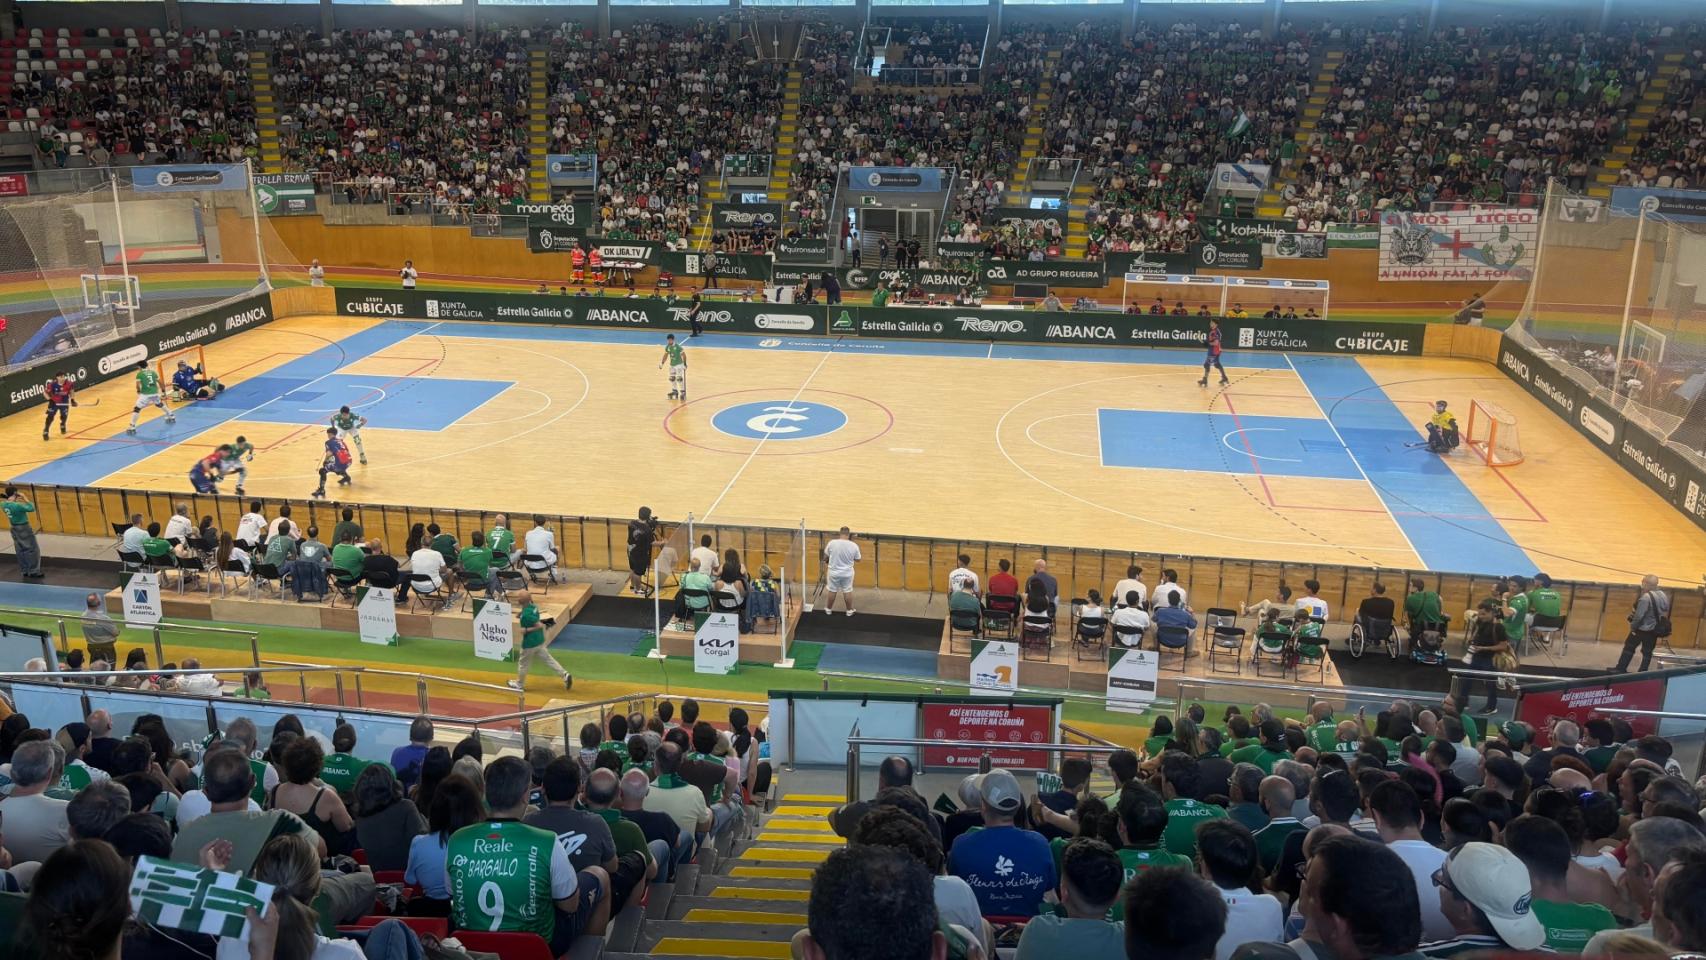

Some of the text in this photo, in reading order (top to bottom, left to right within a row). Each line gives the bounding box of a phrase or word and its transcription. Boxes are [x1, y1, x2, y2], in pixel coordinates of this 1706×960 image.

[284, 174, 310, 184] BRAVA
[516, 204, 574, 214] marineda
[551, 213, 575, 226] city
[1475, 212, 1533, 224] LICEO
[603, 248, 641, 257] OK LIGA.TV
[1030, 270, 1058, 278] GRUPO
[1060, 270, 1099, 279] REGUEIRA
[1381, 270, 1390, 278] A
[1393, 270, 1438, 278] UNION
[1468, 270, 1479, 278] A
[440, 302, 467, 310] XUNTA
[497, 306, 562, 318] Estrella Galicia
[440, 309, 484, 318] DE GALICIA
[861, 320, 931, 333] Estrella Galicia
[158, 327, 209, 352] Estrella Galicia
[1131, 328, 1207, 342] Estrella Galicia
[1257, 330, 1289, 338] XUNTA
[1255, 338, 1308, 348] DE GALICIA
[1535, 374, 1551, 393] Estrella
[10, 382, 45, 404] Estrella
[1623, 439, 1668, 484] Estrella Galicia
[493, 536, 501, 550] 7
[704, 648, 730, 657] Corgal
[1571, 690, 1607, 700] ENTENDEMOS
[1568, 699, 1594, 708] DEPORTE
[949, 707, 1010, 718] ASÍ ENTENDEMOS O
[959, 715, 1025, 727] DEPORTE NA CORUÑA
[473, 838, 514, 854] Reale
[467, 857, 519, 879] BARGALLO
[527, 846, 539, 916] desarrollo
[1005, 877, 1020, 887] de
[477, 880, 505, 932] 9
